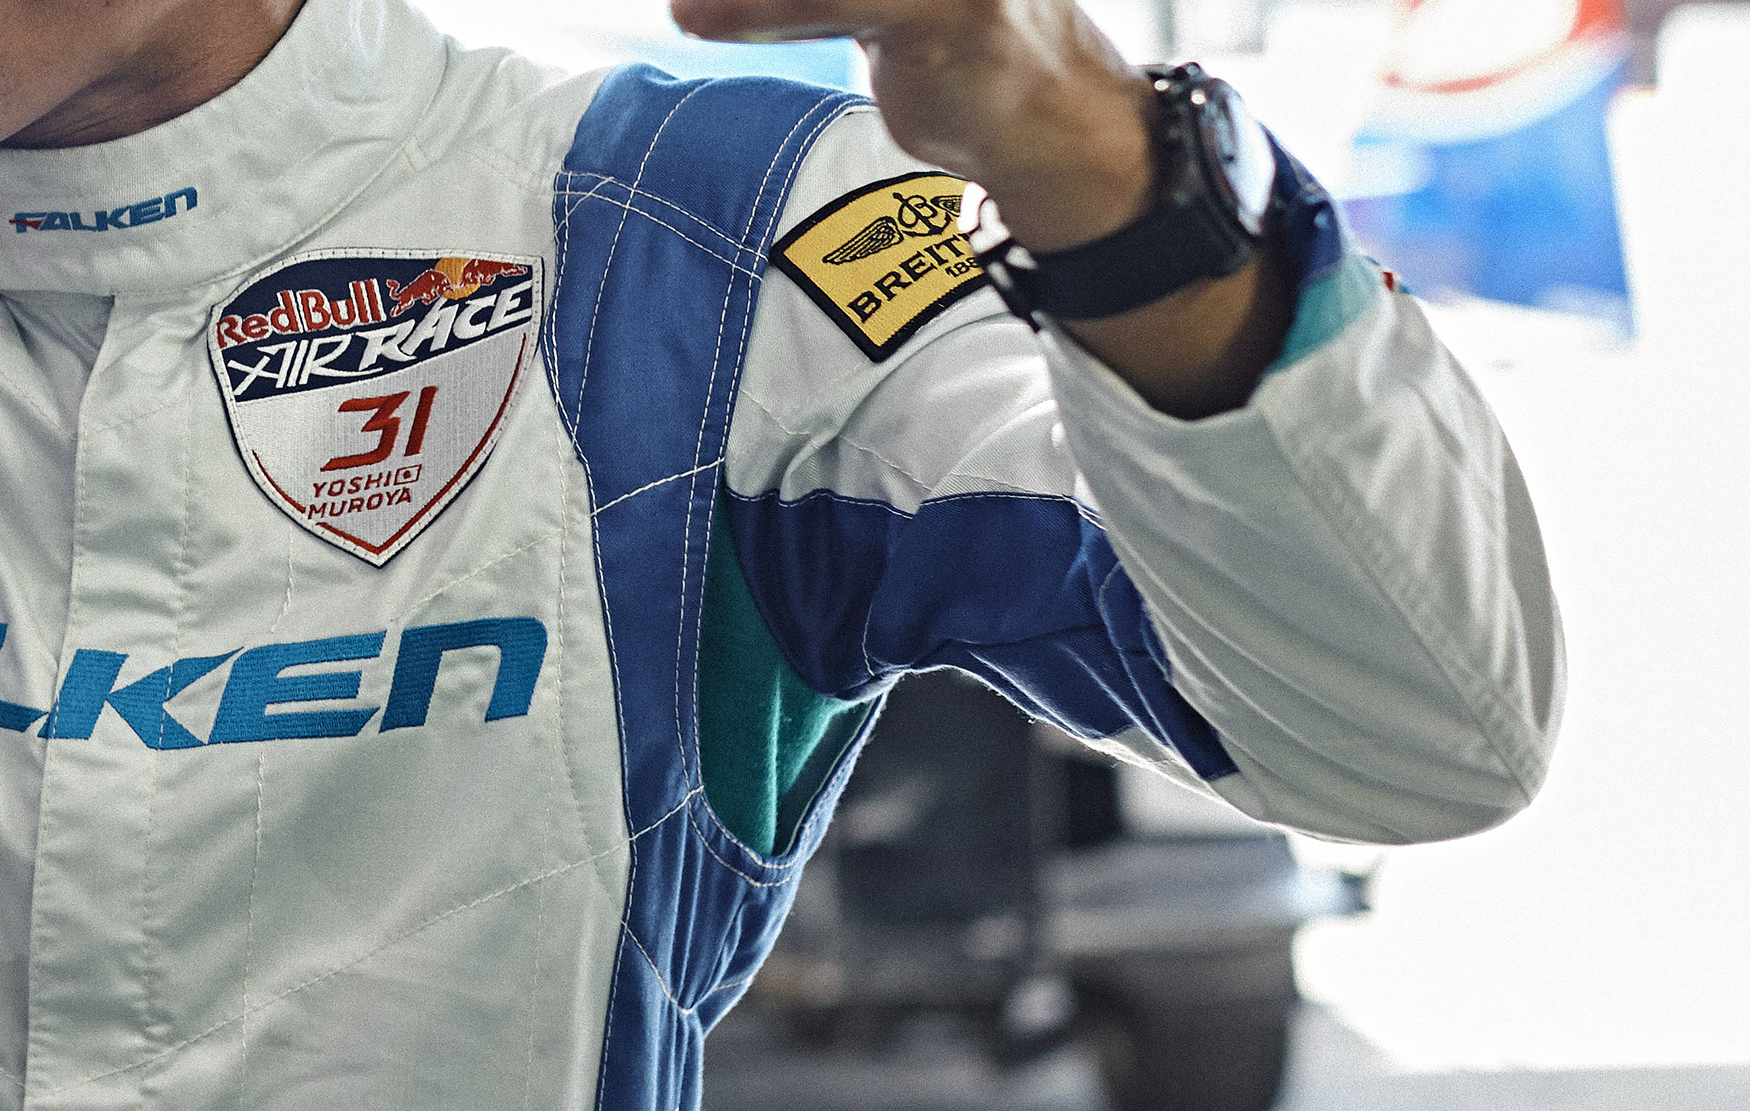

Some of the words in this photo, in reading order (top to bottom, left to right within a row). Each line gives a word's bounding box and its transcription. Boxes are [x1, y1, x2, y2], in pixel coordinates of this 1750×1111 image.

[8, 186, 199, 234] FALKEN
[847, 232, 970, 324] BREIT
[944, 256, 980, 278] 188
[227, 332, 384, 396] AIR
[354, 279, 533, 372] RACE
[319, 385, 439, 473] 31
[307, 486, 412, 520] MUROYA
[312, 470, 392, 498] YOSHI
